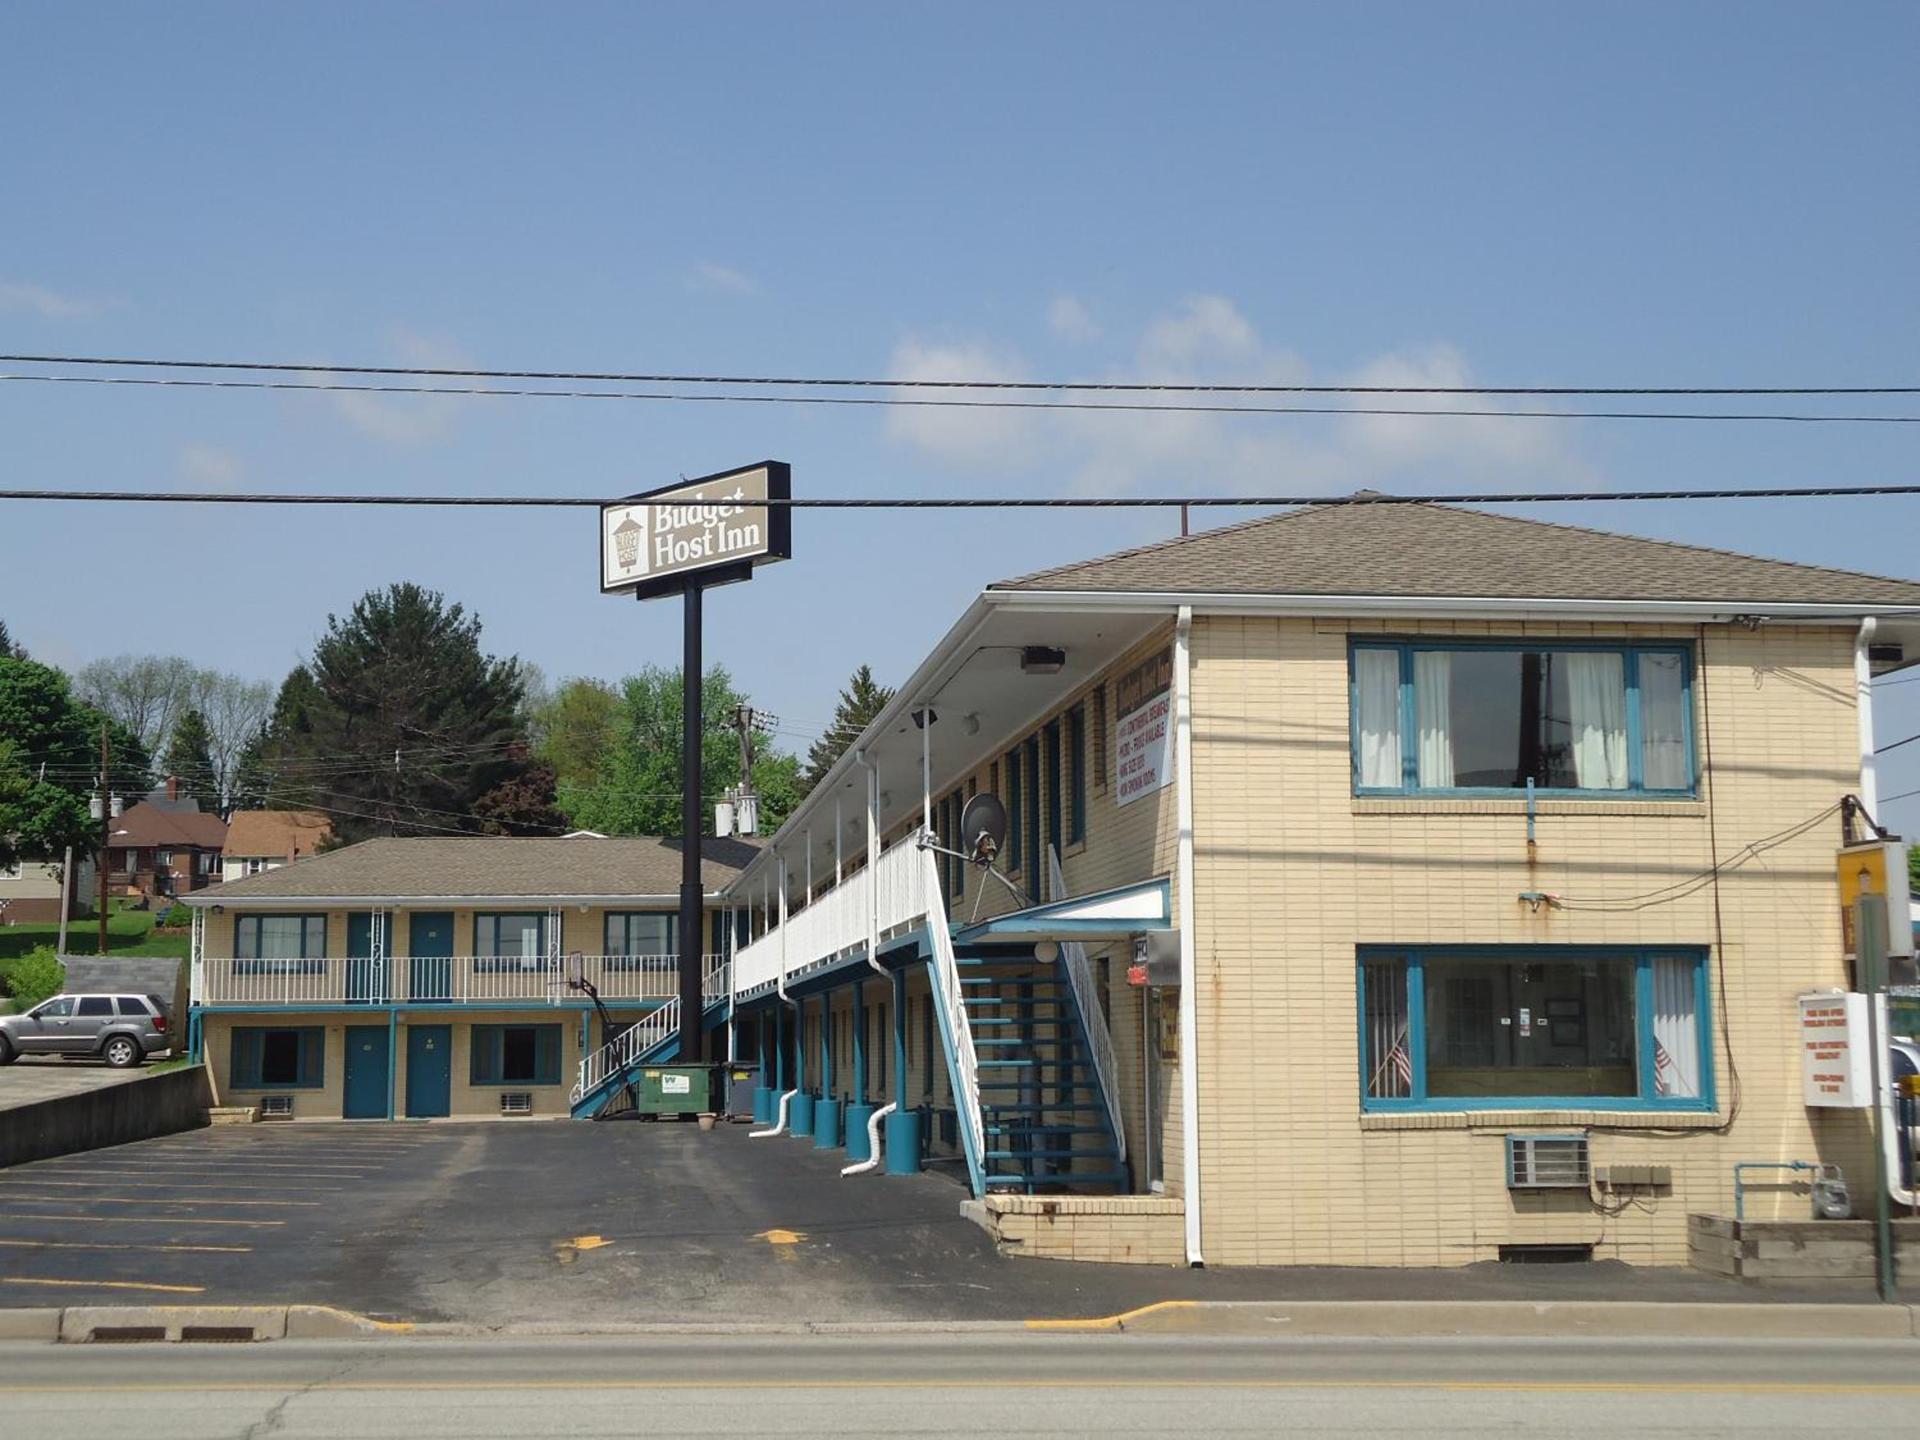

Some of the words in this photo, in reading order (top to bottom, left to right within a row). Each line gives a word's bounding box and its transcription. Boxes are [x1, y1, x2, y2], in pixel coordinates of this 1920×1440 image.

[655, 486, 744, 533] Budget
[655, 529, 714, 567] Host
[718, 521, 760, 553] Inn
